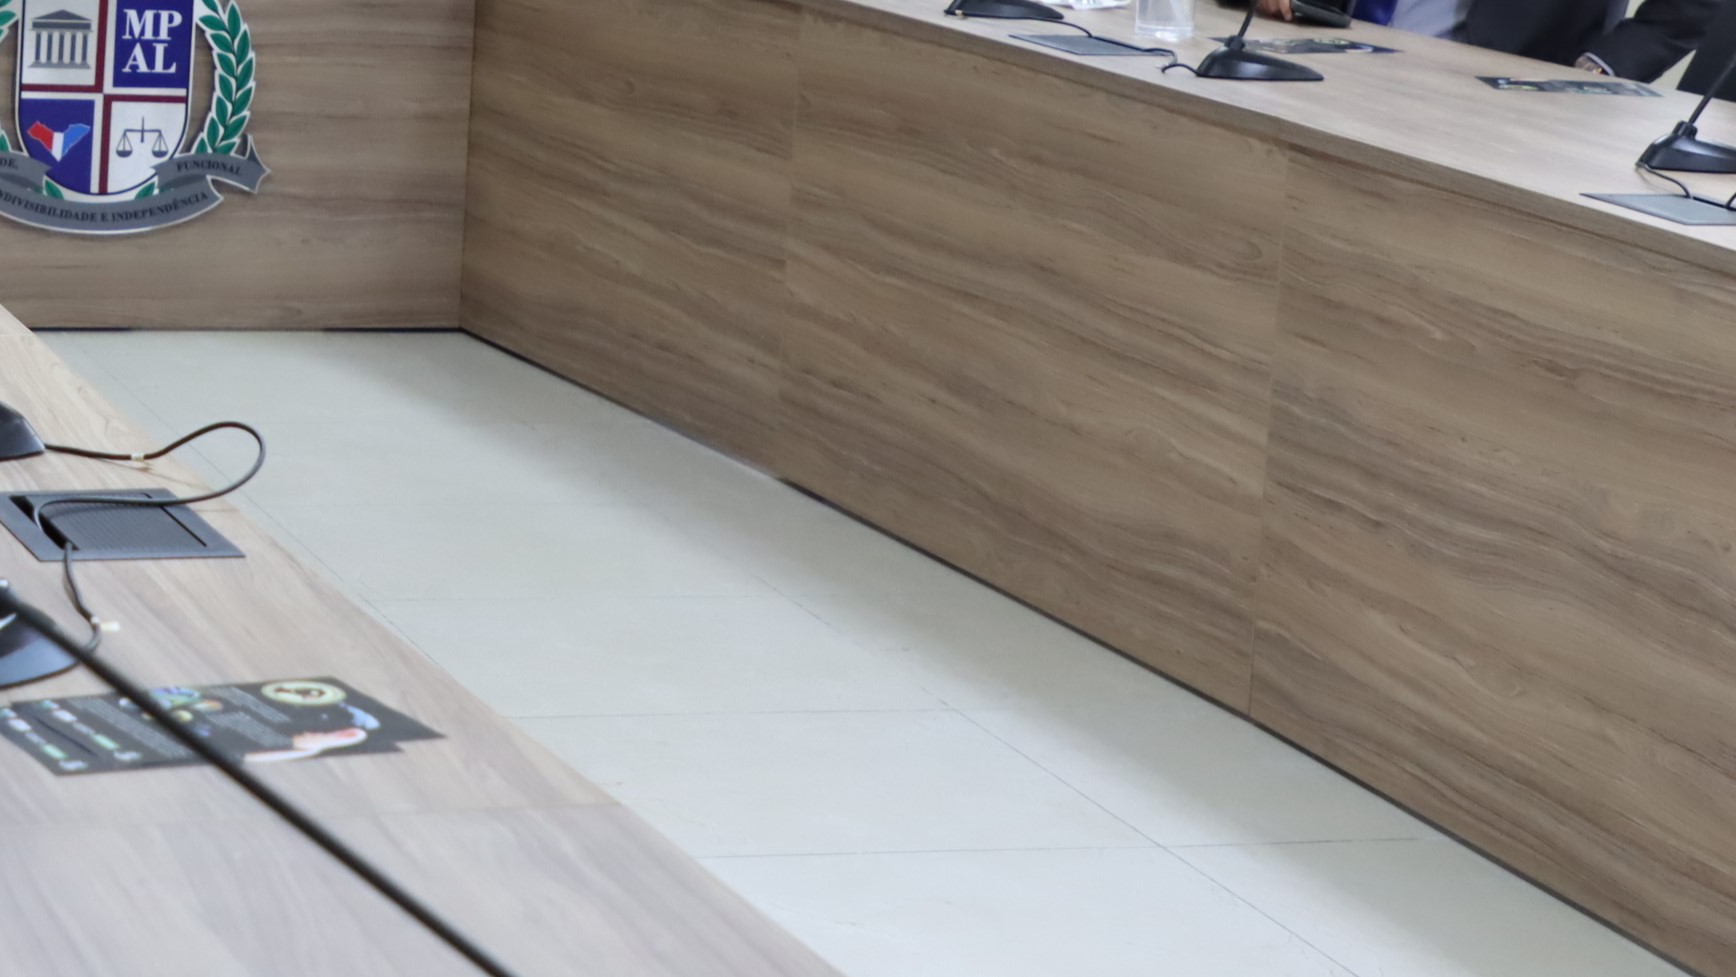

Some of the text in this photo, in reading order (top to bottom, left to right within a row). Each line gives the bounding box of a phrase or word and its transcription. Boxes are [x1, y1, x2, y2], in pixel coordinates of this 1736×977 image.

[121, 8, 183, 40] MP
[121, 41, 177, 74] AL
[176, 160, 242, 175] FUNCIONAL
[100, 212, 110, 222] E
[111, 192, 209, 222] INDEPENDÊNCIA
